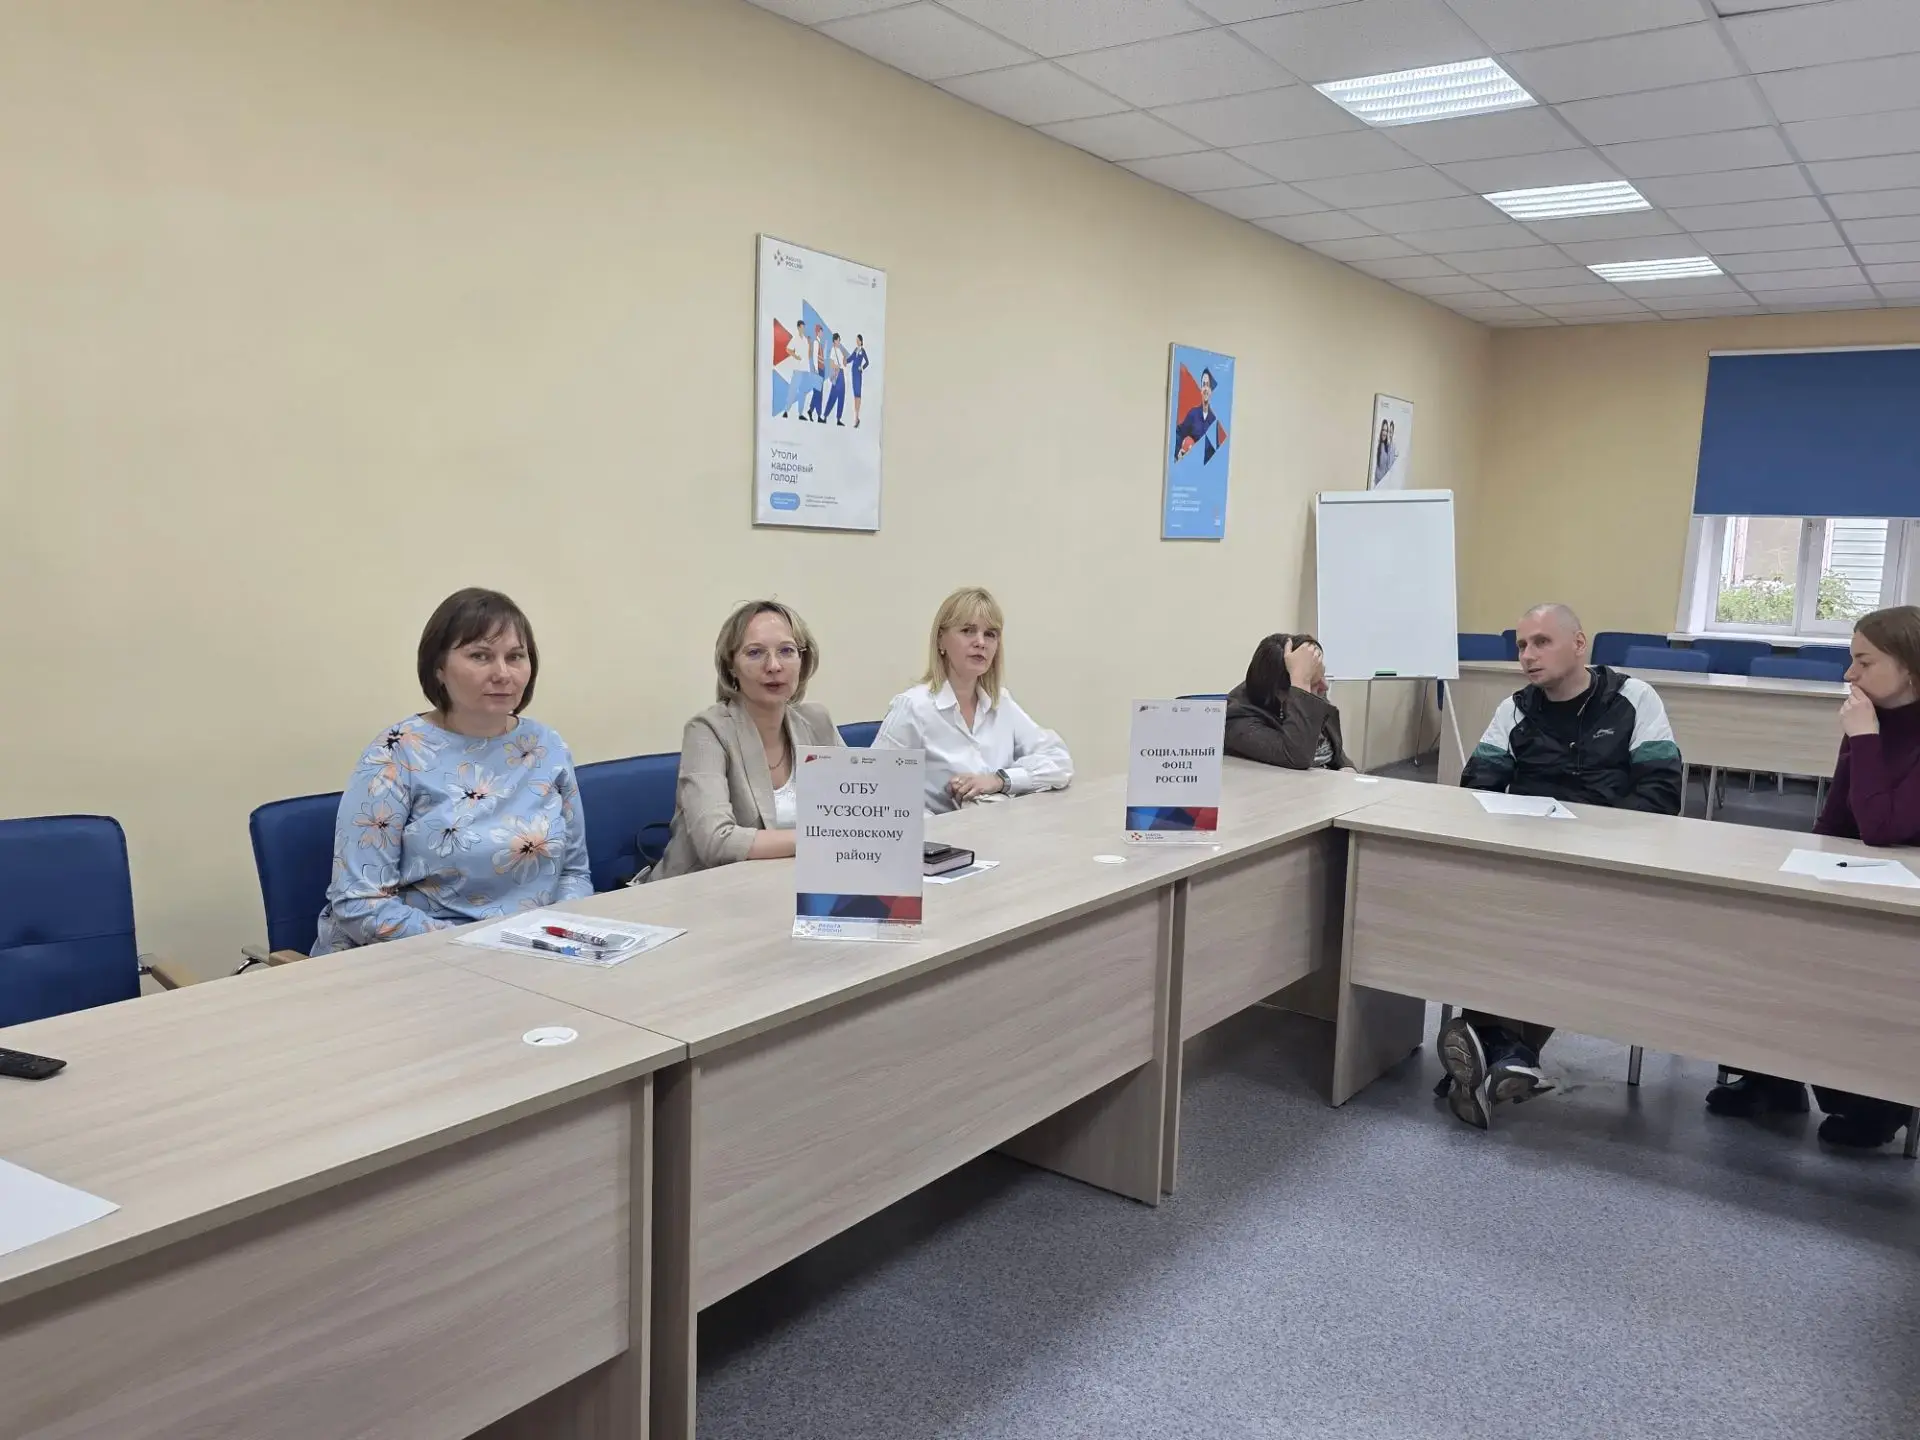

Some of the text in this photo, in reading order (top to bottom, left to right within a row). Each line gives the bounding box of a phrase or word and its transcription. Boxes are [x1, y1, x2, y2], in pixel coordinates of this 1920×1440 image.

[770, 448, 798, 460] Утоли
[771, 462, 814, 473] кадровый
[770, 472, 799, 484] голод!
[1140, 747, 1216, 758] СОЦИАЛЬНЫЙ
[1162, 761, 1193, 770] ФОНД
[1155, 775, 1198, 783] РОССИИ
[839, 782, 879, 794] ОГБУ
[816, 804, 910, 818] "УСЗСОН" по
[806, 826, 904, 841] Шелеховскому
[836, 849, 882, 863] району
